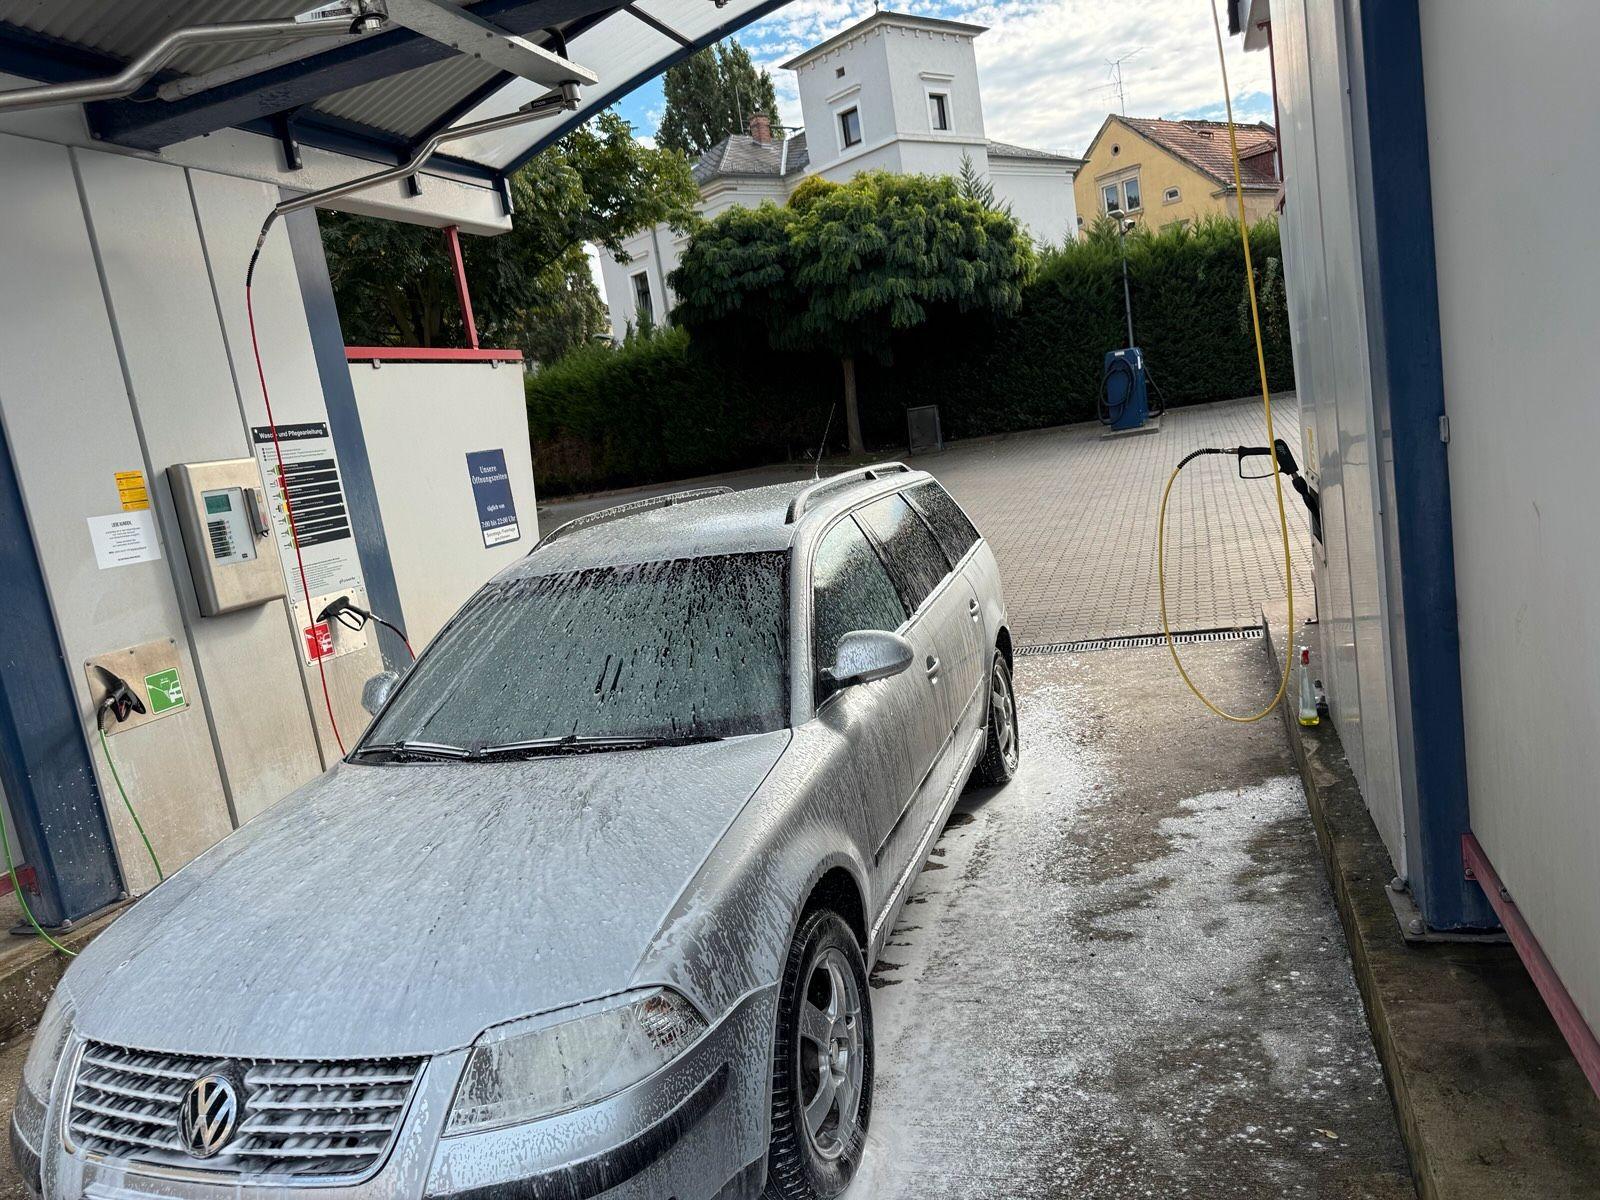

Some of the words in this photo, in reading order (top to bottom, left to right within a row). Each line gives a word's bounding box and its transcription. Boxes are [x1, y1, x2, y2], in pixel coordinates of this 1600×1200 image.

[259, 431, 278, 439] Wasc-
[288, 428, 323, 438] Pflegeanleitung
[472, 473, 507, 484] Öffnungszeiten
